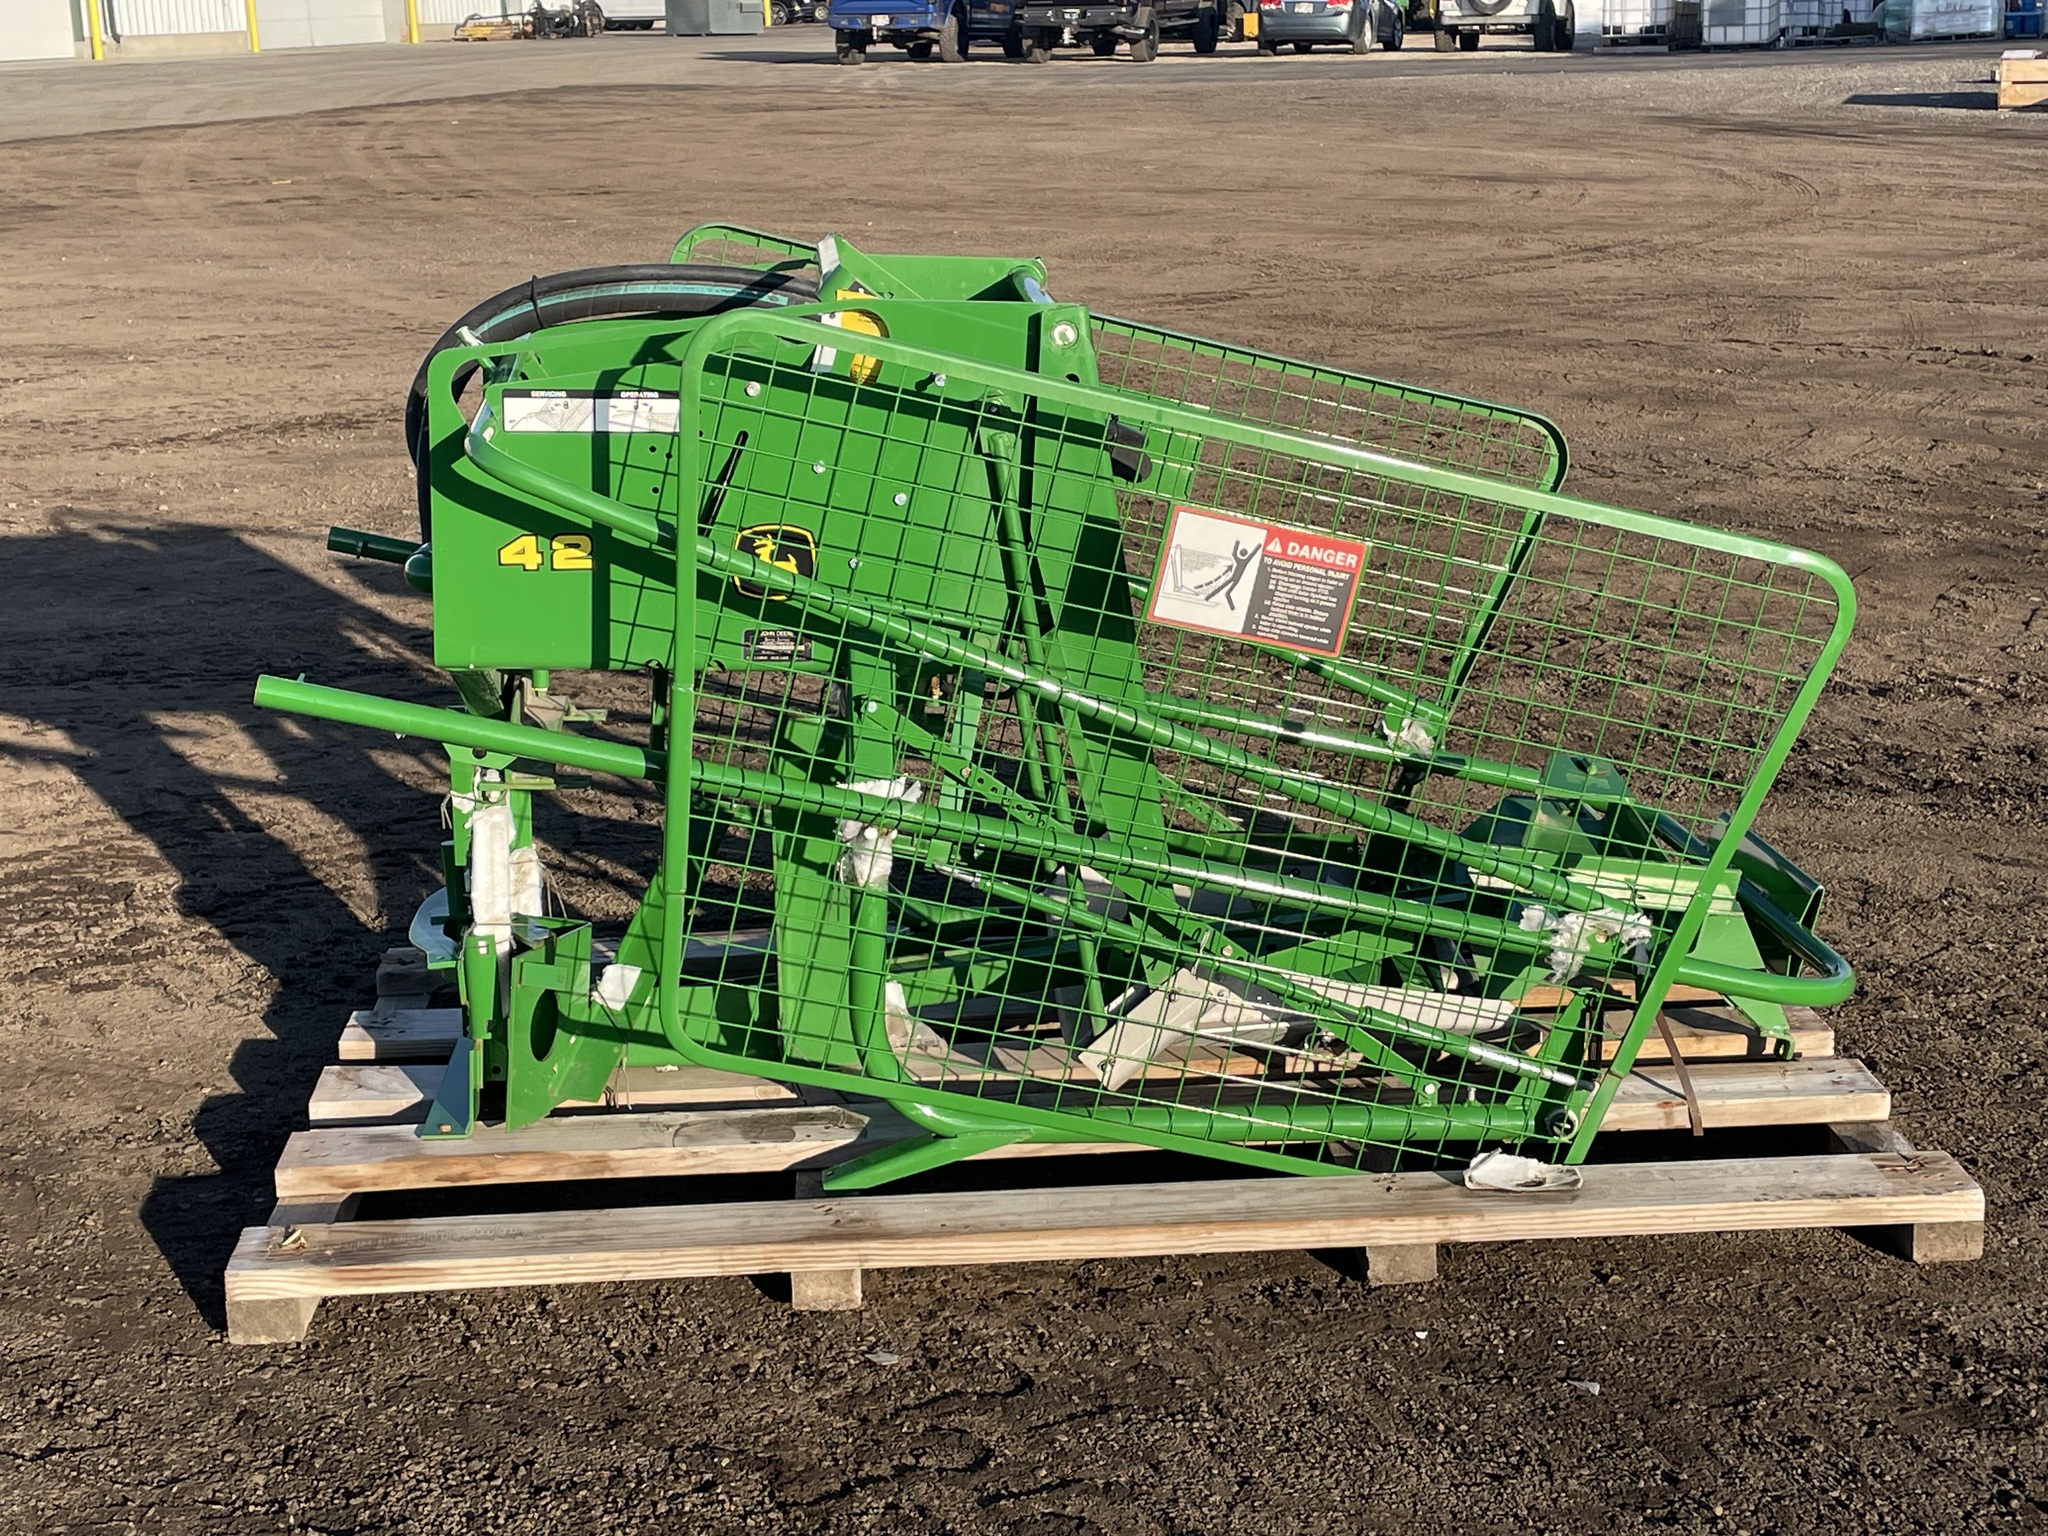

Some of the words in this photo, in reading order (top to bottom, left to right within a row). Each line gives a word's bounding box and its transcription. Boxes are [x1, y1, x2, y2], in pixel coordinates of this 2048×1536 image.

[620, 391, 659, 399] OPERATING
[498, 532, 593, 571] 42
[1287, 541, 1358, 569] DANGER
[1263, 556, 1273, 565] TO
[1272, 558, 1293, 569] AVOID
[1293, 561, 1326, 576] PERSONAL
[1327, 568, 1351, 580] INJURY
